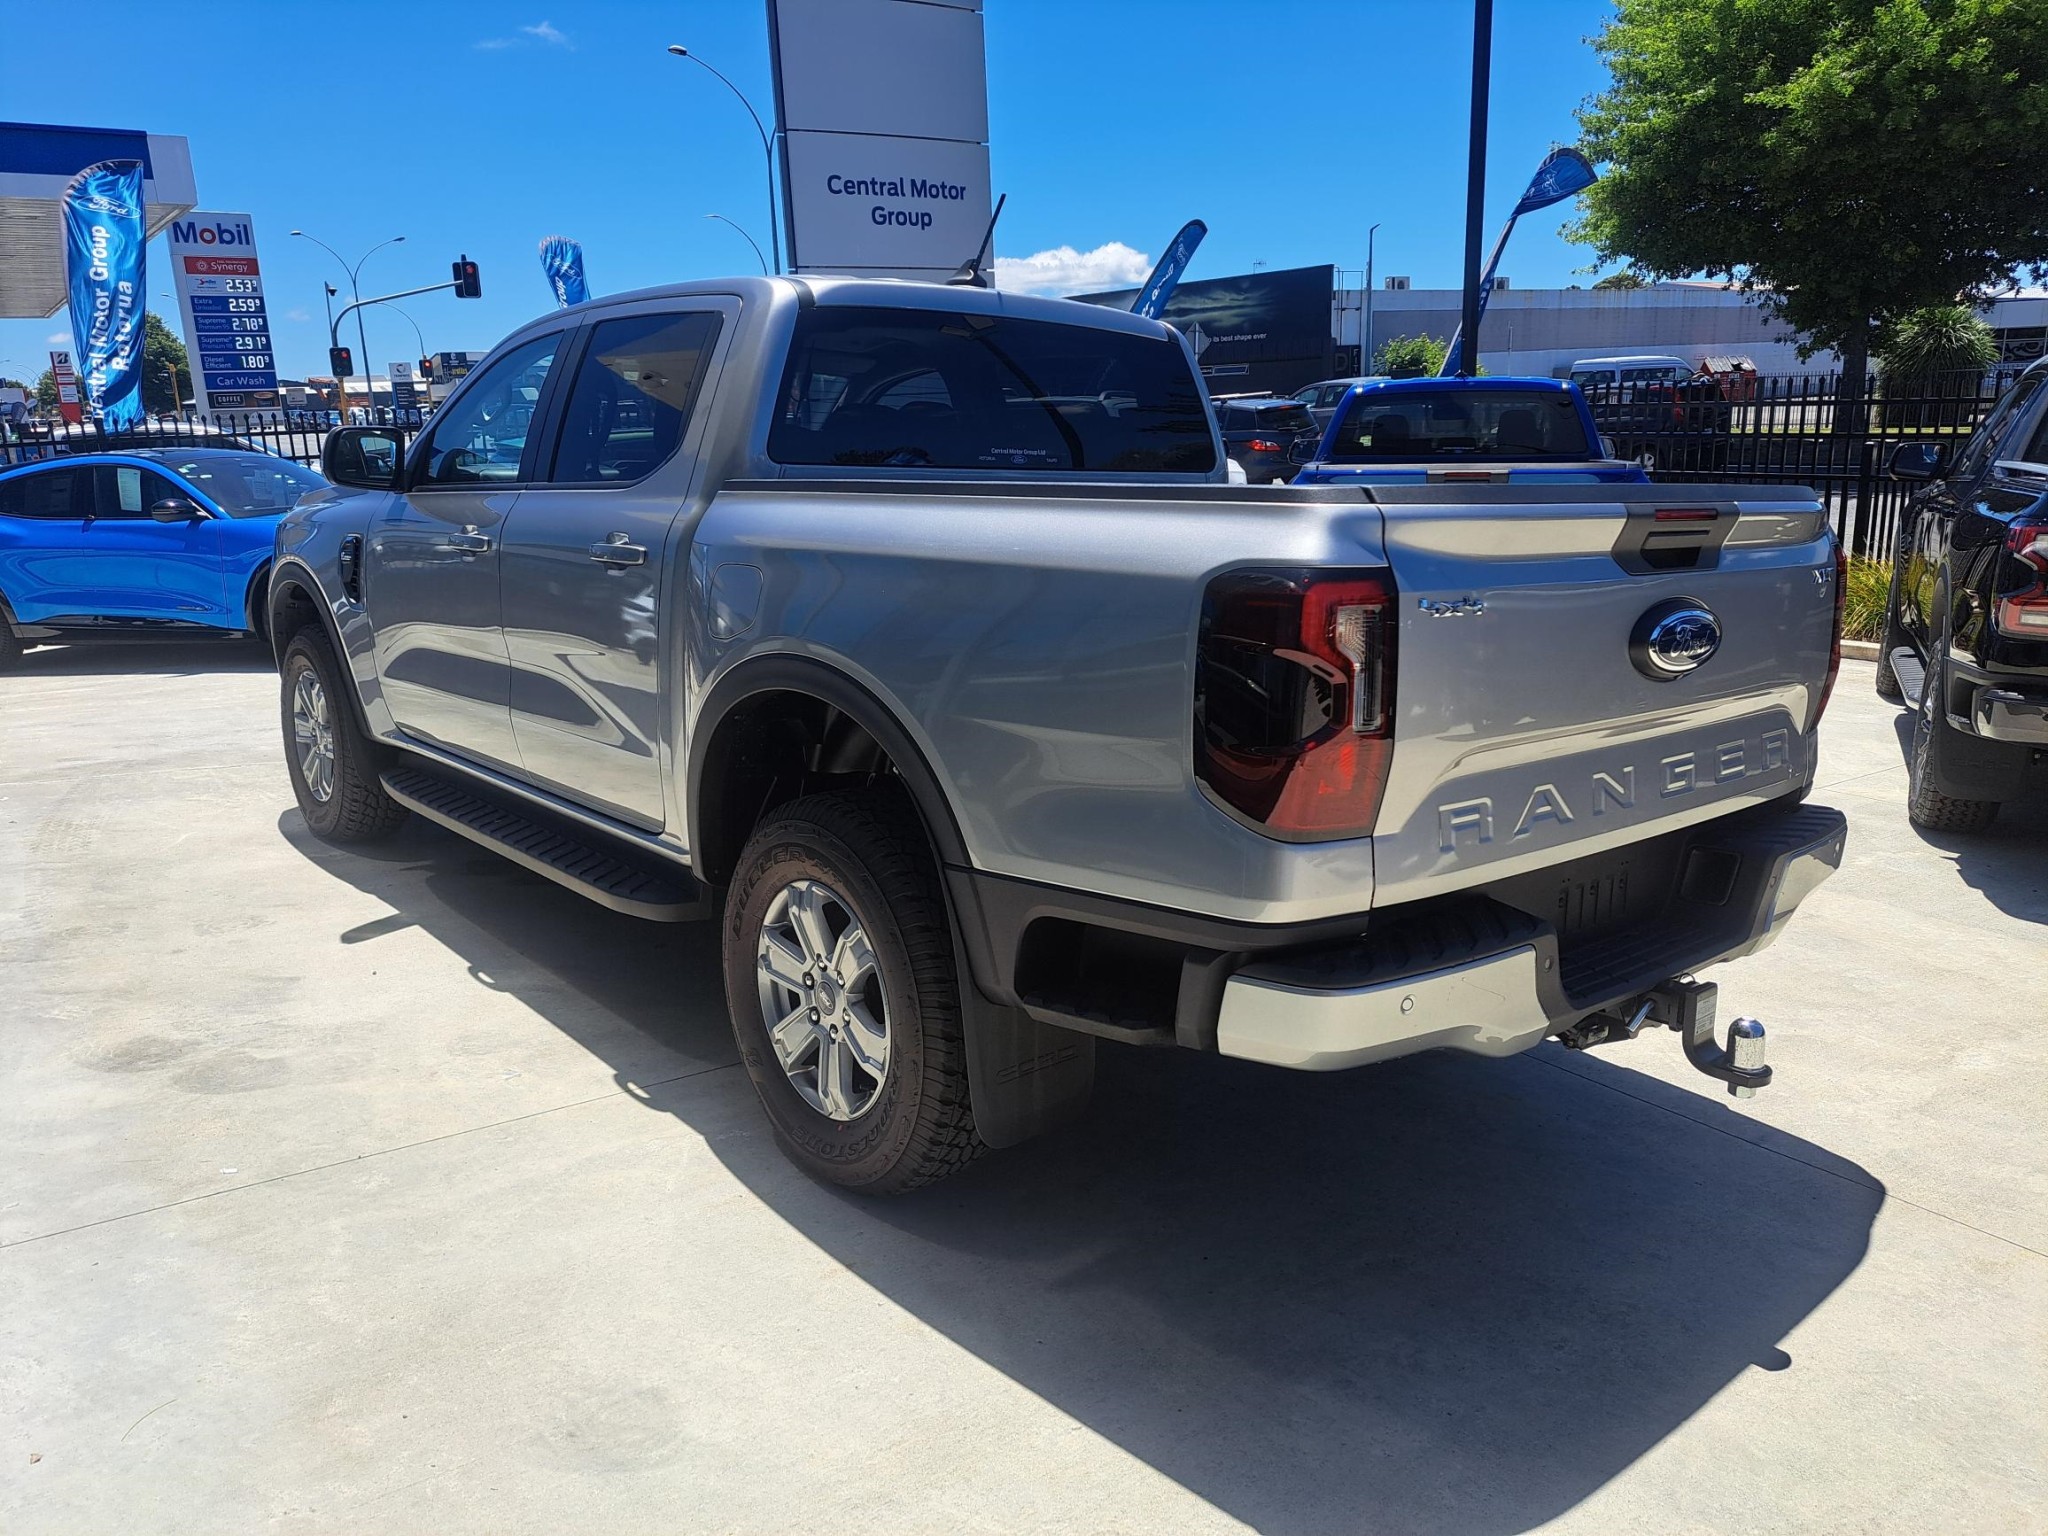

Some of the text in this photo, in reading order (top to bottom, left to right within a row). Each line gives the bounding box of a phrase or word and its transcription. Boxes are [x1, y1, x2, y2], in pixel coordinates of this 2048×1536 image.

[827, 174, 966, 200] Central Motor
[88, 195, 129, 215] Ford
[871, 206, 933, 230] Group
[172, 221, 251, 246] Mobil
[89, 225, 111, 281] Group
[210, 261, 248, 272] Synergy
[90, 288, 110, 347] Motor
[111, 280, 133, 372] Rotorua
[1234, 333, 1252, 342] shape
[1253, 332, 1267, 340] ever
[217, 376, 265, 386] Car Wash
[1670, 623, 1711, 657] Ford
[1438, 727, 1791, 853] RANGER
